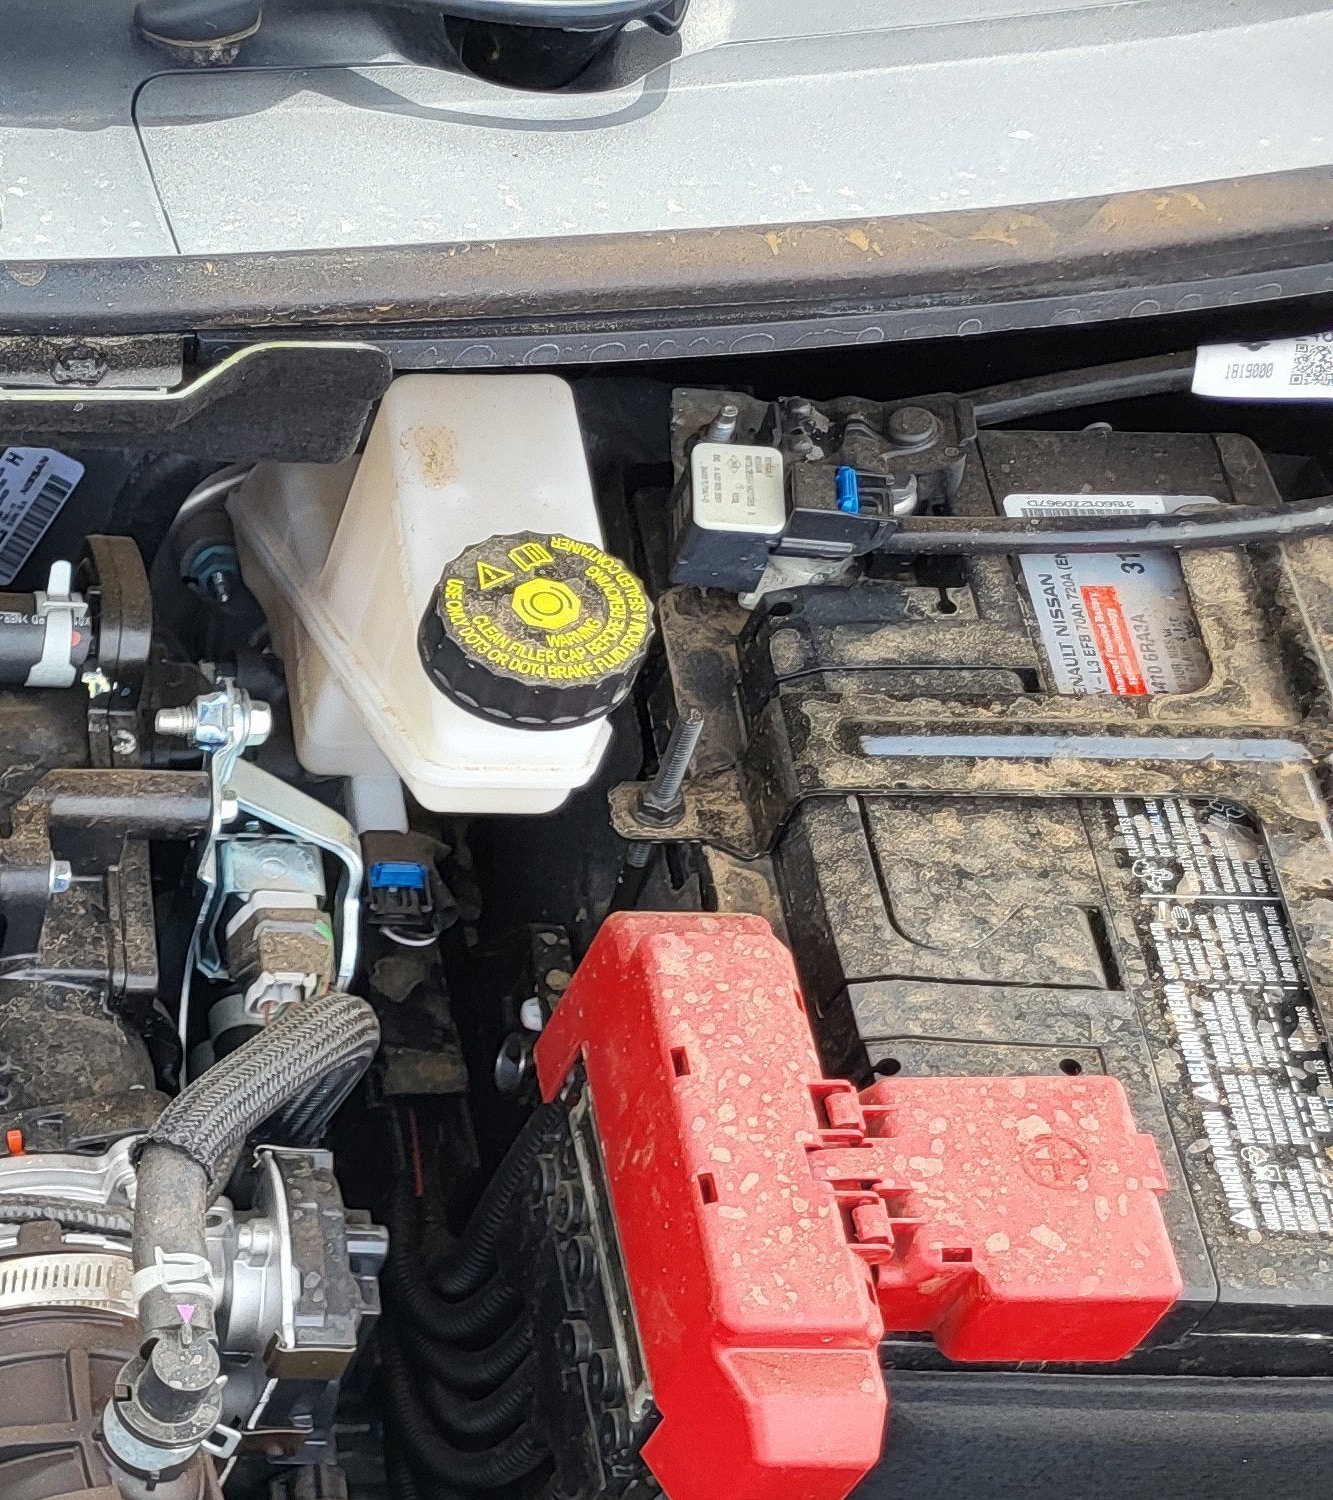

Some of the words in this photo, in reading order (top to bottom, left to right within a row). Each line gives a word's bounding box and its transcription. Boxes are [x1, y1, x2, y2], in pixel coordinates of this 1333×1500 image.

[550, 536, 622, 578] CONTAINER
[445, 578, 464, 602] USE
[585, 566, 627, 617] REMOVING
[617, 573, 647, 612] SEALED
[1037, 573, 1070, 636] NISSAN
[446, 601, 470, 627] ONLY
[635, 612, 647, 622] A
[458, 624, 488, 653] DOT3
[472, 614, 508, 649] CLEAN
[545, 617, 603, 648] WARNING
[587, 617, 625, 656] BEFORE
[619, 620, 646, 648] FROM
[487, 649, 508, 665] OR
[507, 641, 557, 663] FILLER
[558, 646, 587, 663] CAP
[595, 643, 630, 673] FLUID
[508, 657, 546, 678] DOT4
[547, 662, 595, 680] BRAKE
[1057, 642, 1087, 695] ENAULT
[1107, 658, 1128, 695] nhanced
[1148, 922, 1167, 940] ACID
[1154, 942, 1178, 979] SULFURIC
[1170, 939, 1190, 963] CAUSE
[1178, 964, 1195, 979] CAN
[1163, 985, 1212, 1082] PELIGRO/VENENO
[1293, 1005, 1317, 1042] CHISPAS
[1286, 1037, 1304, 1050] NO
[1302, 1095, 1331, 1132] ÉVITER
[1253, 1129, 1272, 1143] LES
[1200, 1110, 1251, 1207] DANGER/POISON
